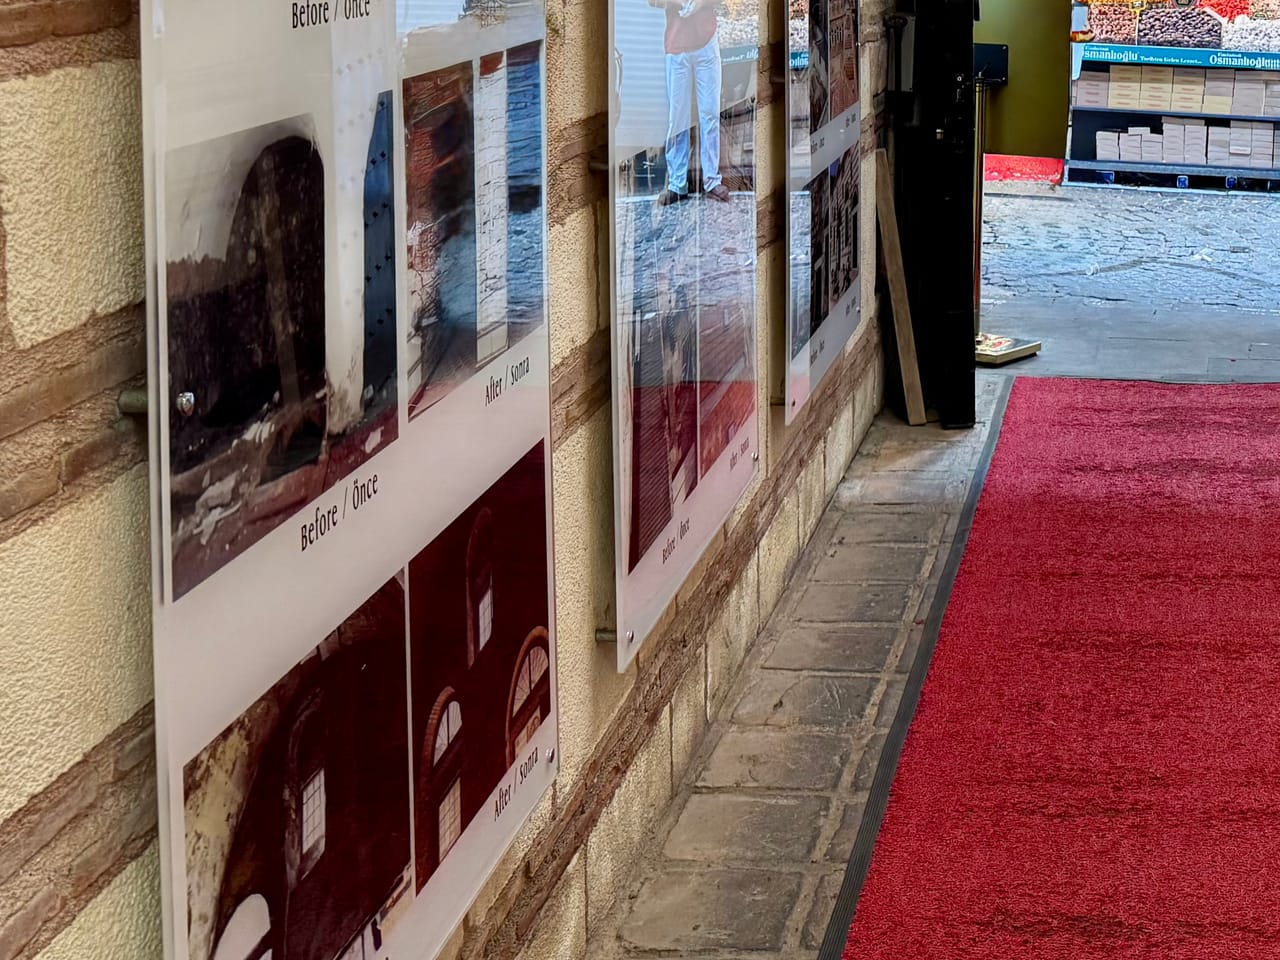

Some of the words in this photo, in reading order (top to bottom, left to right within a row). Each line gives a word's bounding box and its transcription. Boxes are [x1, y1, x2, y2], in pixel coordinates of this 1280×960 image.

[485, 375, 502, 407] After
[510, 356, 530, 386] Sonra
[301, 505, 338, 552] Before
[352, 474, 378, 510] Önce
[494, 784, 511, 822] After
[520, 746, 538, 785] Sonra
